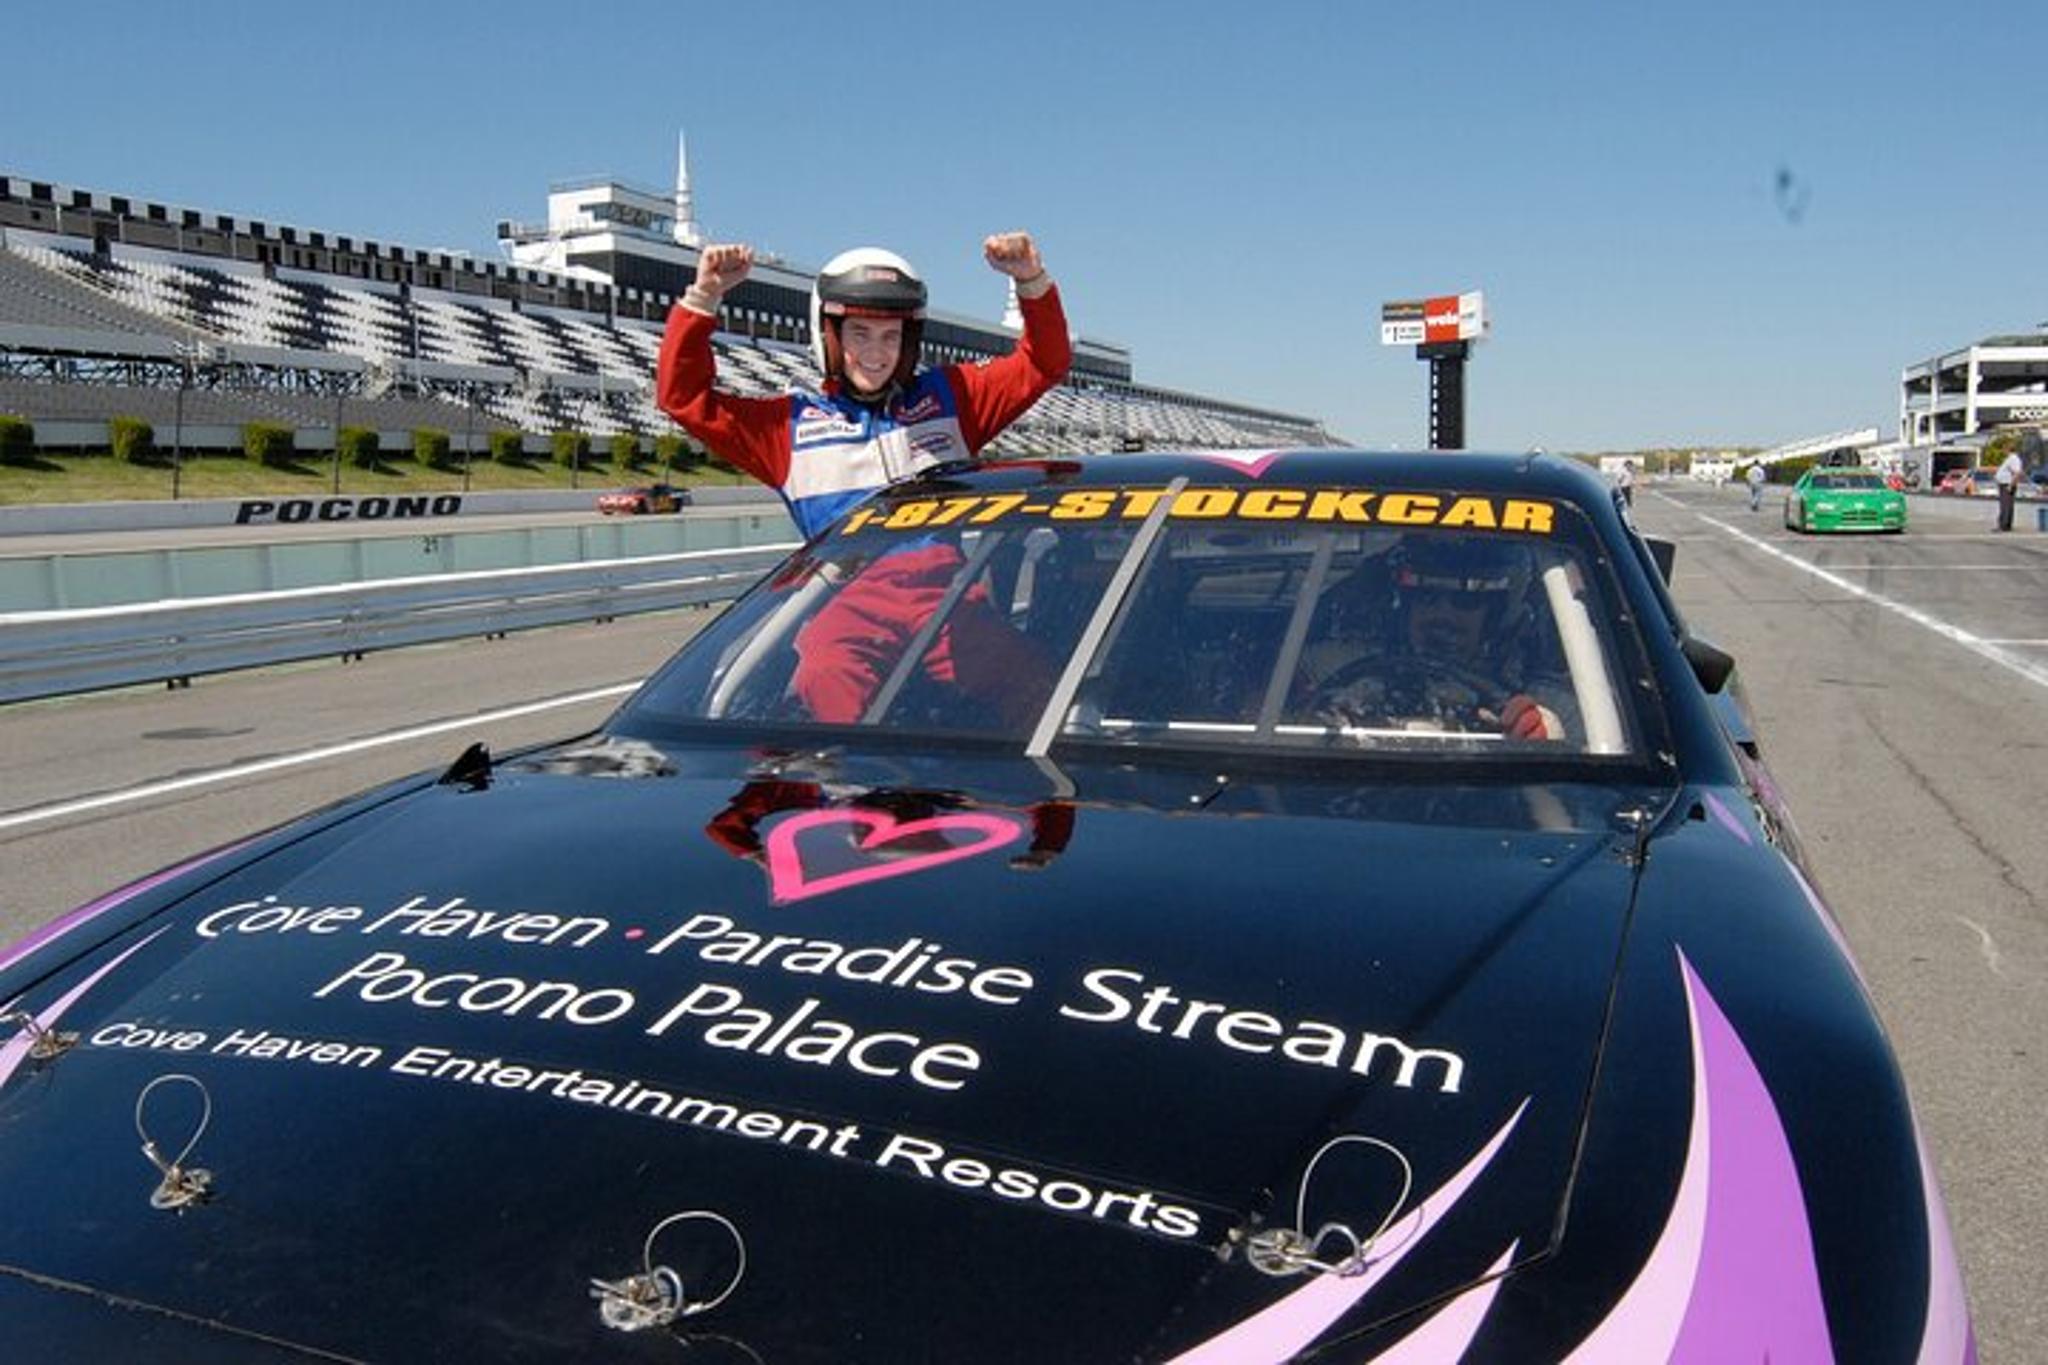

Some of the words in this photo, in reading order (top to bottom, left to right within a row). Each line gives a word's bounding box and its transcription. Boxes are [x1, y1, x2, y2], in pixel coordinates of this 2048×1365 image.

[236, 495, 462, 524] POCONO
[841, 490, 1554, 535] 1-877-STOCKCAR
[195, 896, 363, 938] Cove
[362, 896, 609, 948] Haven
[646, 914, 1034, 1005] Paradise
[1060, 969, 1464, 1093] Stream
[313, 952, 635, 1026] Pocono
[646, 983, 981, 1090] Palace
[90, 1022, 208, 1051] Cove
[210, 1029, 382, 1069] Haven
[390, 1046, 860, 1158] Entertainment
[876, 1134, 1200, 1238] Resorts
